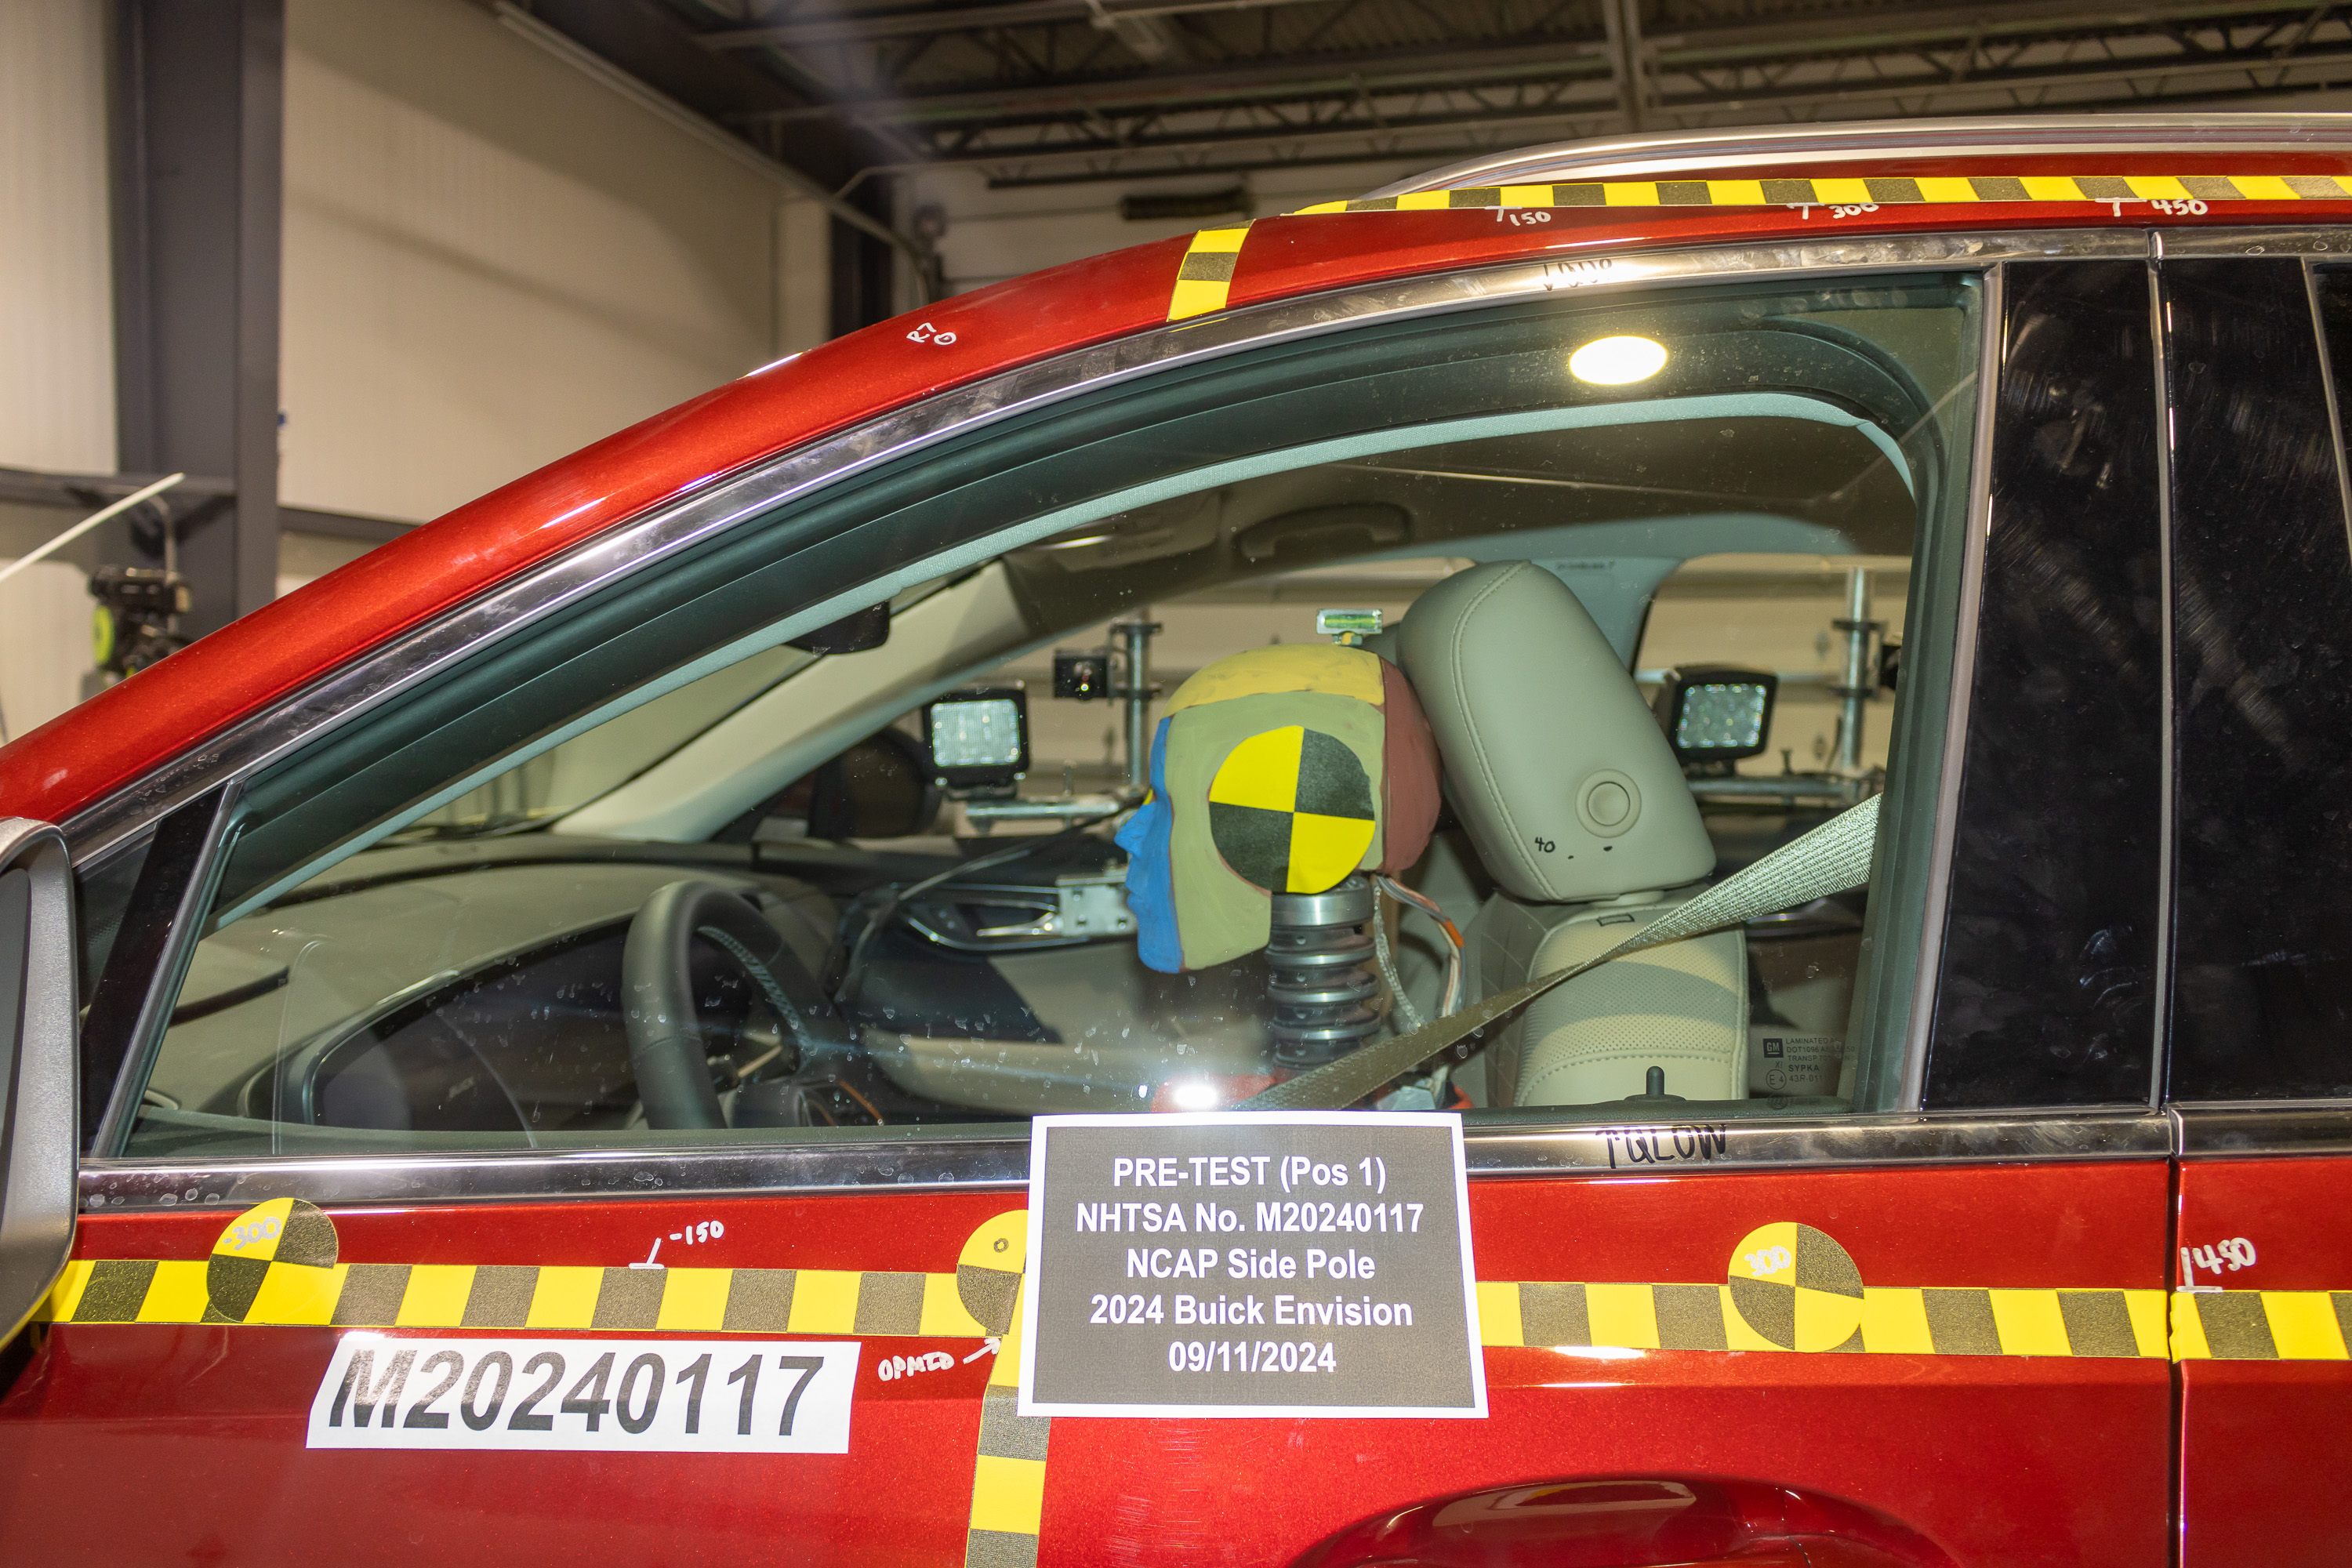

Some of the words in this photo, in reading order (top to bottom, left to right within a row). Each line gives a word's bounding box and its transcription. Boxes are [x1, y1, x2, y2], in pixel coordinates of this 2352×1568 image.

[1509, 210, 1552, 227] 150
[1831, 203, 1880, 220] 300
[2151, 199, 2209, 216] 450
[1534, 837, 1555, 853] 40
[1766, 1042, 1780, 1051] GM
[1788, 1064, 1820, 1073] SYPKA
[1113, 1156, 1270, 1187] PRE-TEST
[1279, 1156, 1349, 1193] (Pos
[1358, 1156, 1387, 1194] 1)
[1076, 1202, 1187, 1232] NHTSA
[1195, 1203, 1246, 1232] No.
[1256, 1202, 1425, 1232] M20240117
[669, 1220, 724, 1245] -150
[1126, 1249, 1219, 1279] NCAP
[1227, 1248, 1297, 1279] Side
[1307, 1248, 1375, 1279] Pole
[1089, 1294, 1164, 1324] 2024
[1174, 1294, 1265, 1325] Buick
[1274, 1294, 1413, 1327] Envision
[1168, 1341, 1337, 1373] 09/11/2024
[328, 1348, 824, 1436] M20240117
